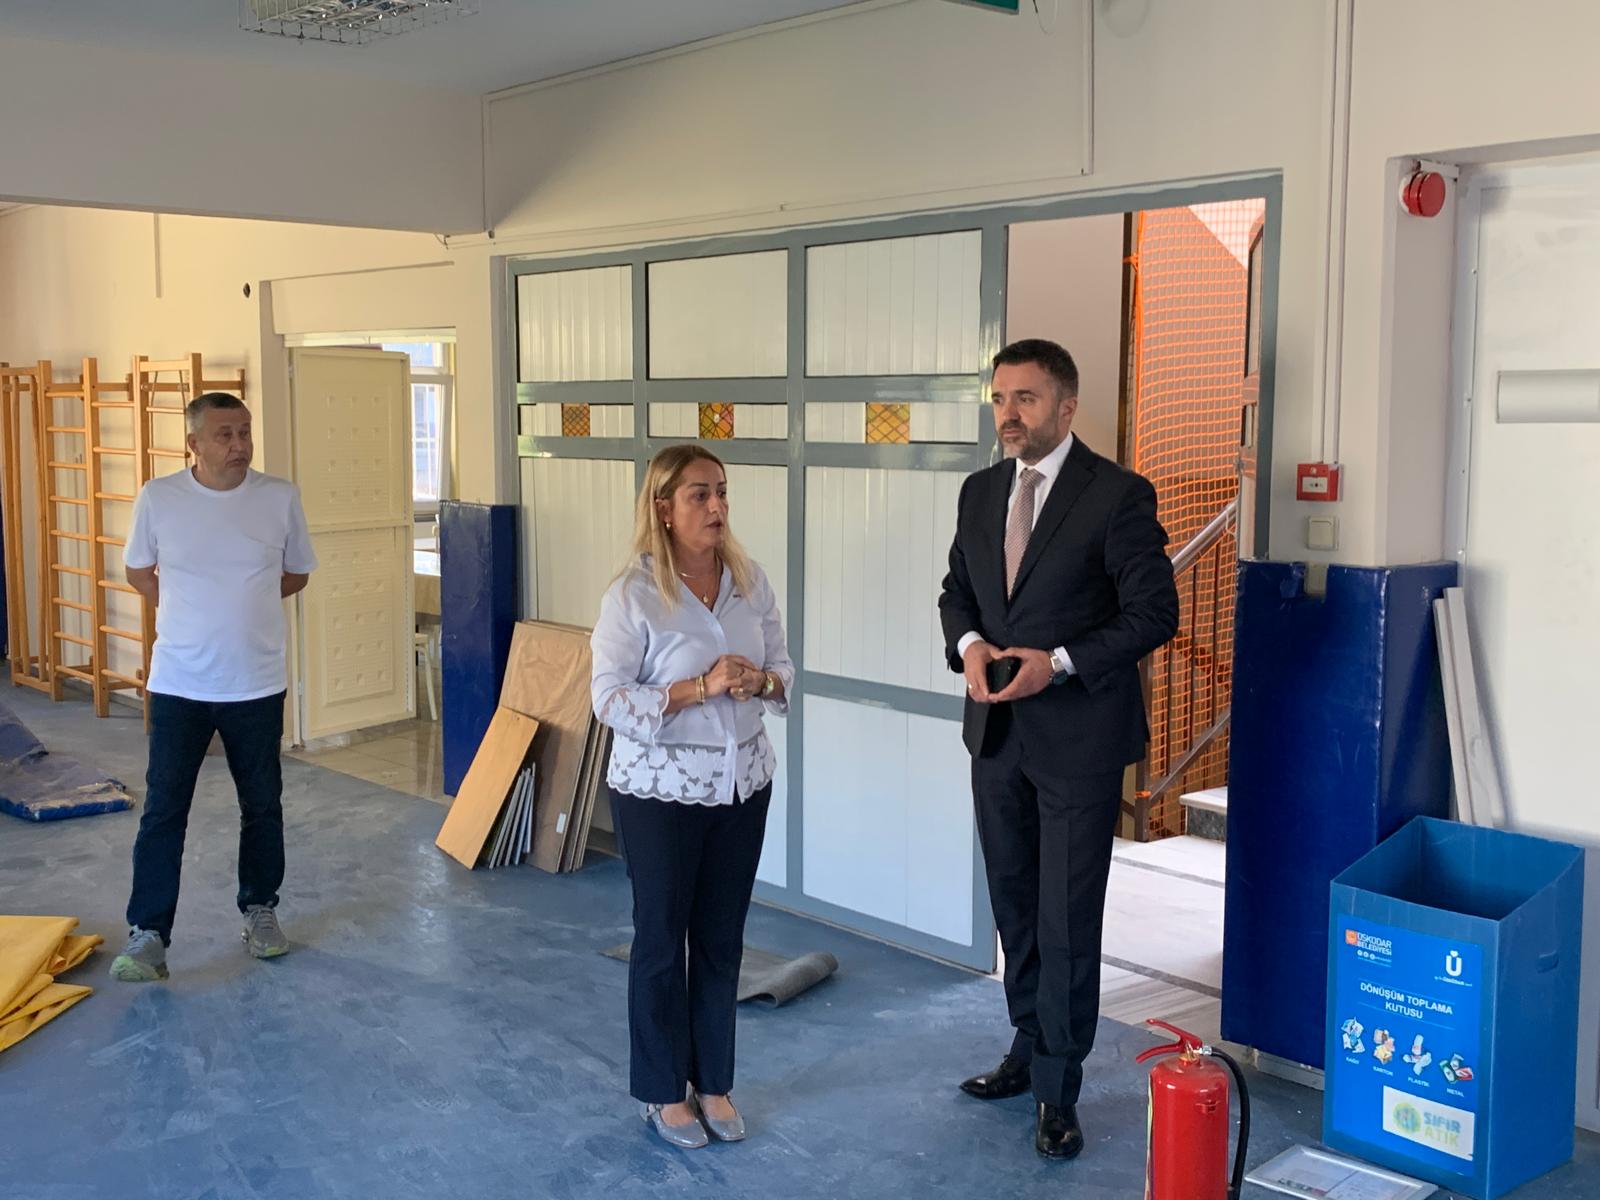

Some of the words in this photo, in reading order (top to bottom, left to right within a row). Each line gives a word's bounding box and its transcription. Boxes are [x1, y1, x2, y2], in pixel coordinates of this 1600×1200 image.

[1360, 982, 1405, 1002] DÖNÜŞÜM
[1406, 995, 1453, 1015] TOPLAMA
[1385, 1001, 1424, 1019] KUTUSU
[1423, 1111, 1461, 1134] SIFIR
